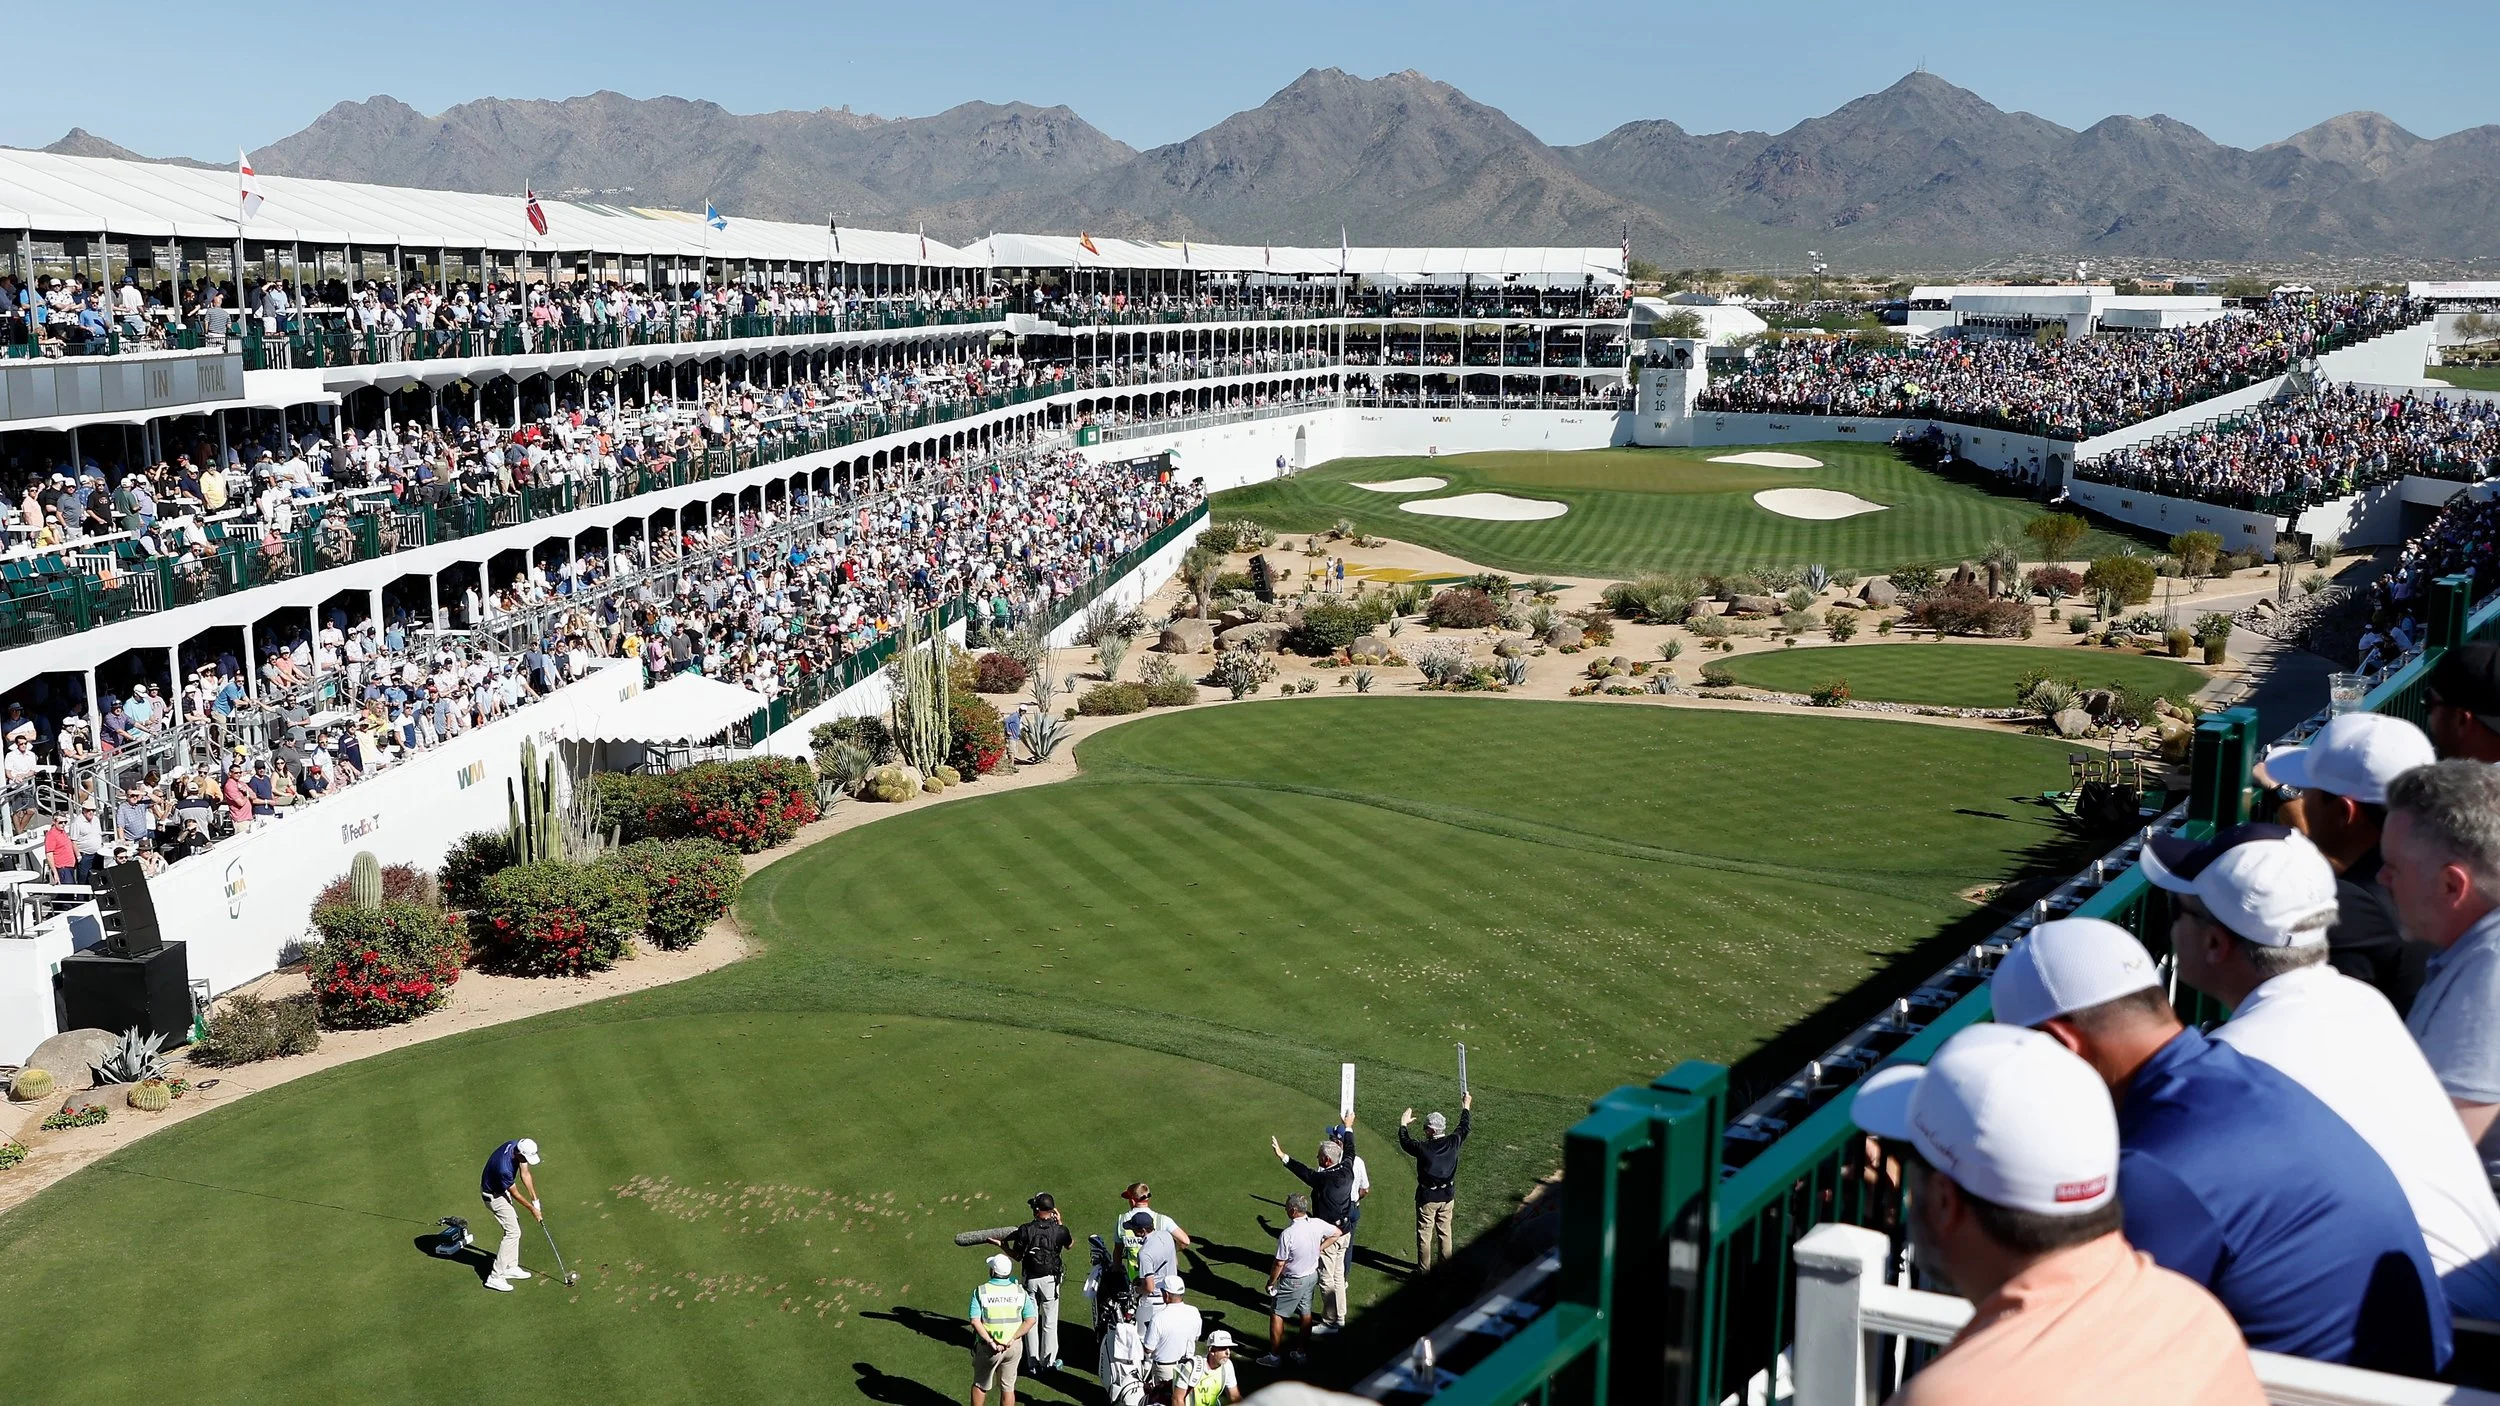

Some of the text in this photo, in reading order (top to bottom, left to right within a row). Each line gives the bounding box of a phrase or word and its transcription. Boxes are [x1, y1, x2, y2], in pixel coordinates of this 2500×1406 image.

[152, 369, 169, 398] IN
[200, 364, 226, 393] TOTAL
[1654, 400, 1666, 411] 16
[1837, 425, 1857, 433] WM
[619, 682, 639, 702] WM
[456, 759, 486, 790] WM
[350, 818, 373, 841] FedEx
[224, 877, 247, 898] WM
